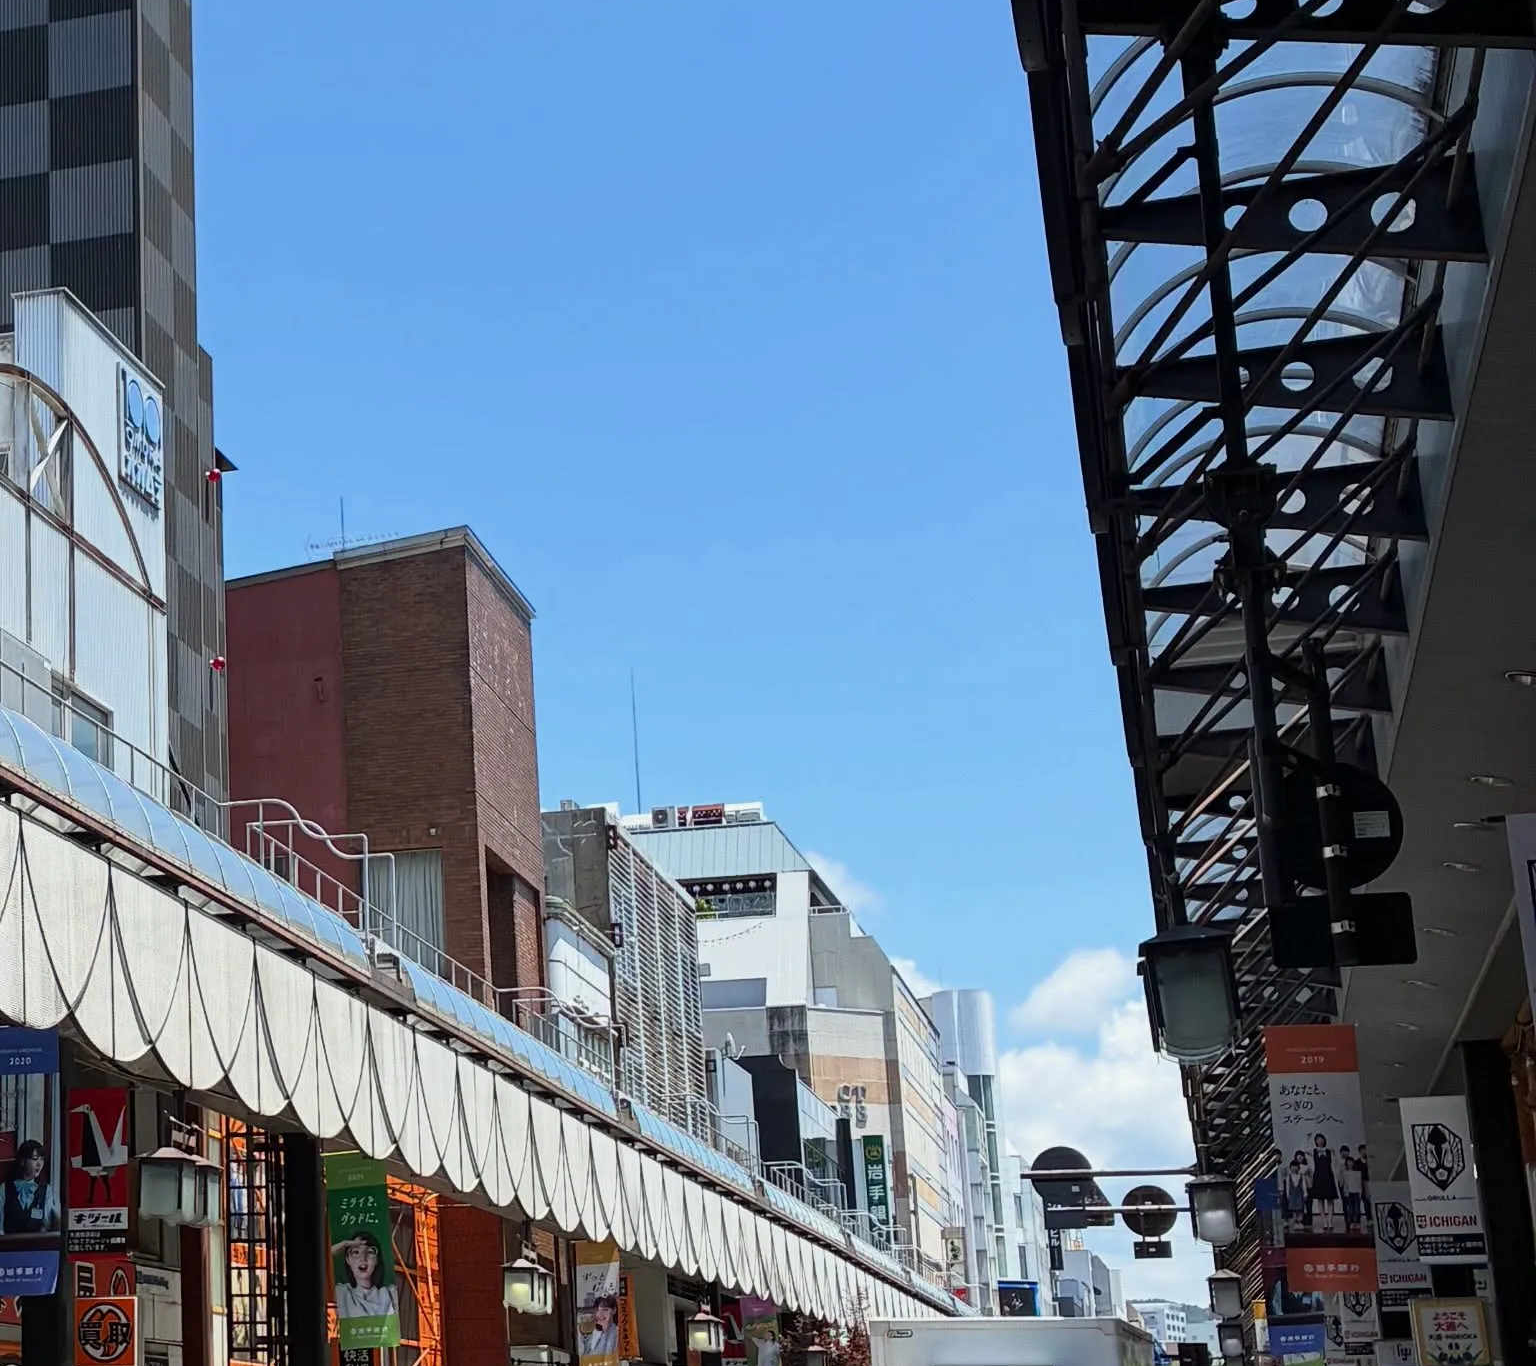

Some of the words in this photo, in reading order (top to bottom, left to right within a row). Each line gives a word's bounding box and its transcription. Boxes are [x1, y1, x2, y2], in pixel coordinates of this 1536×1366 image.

[9, 1057, 31, 1066] 2020
[1280, 1100, 1313, 1111] つぎの
[867, 1164, 888, 1225] 岩手銀
[1429, 1215, 1477, 1227] ICHIGAN
[79, 1321, 130, 1347] 買取
[343, 1349, 369, 1362] 快活
